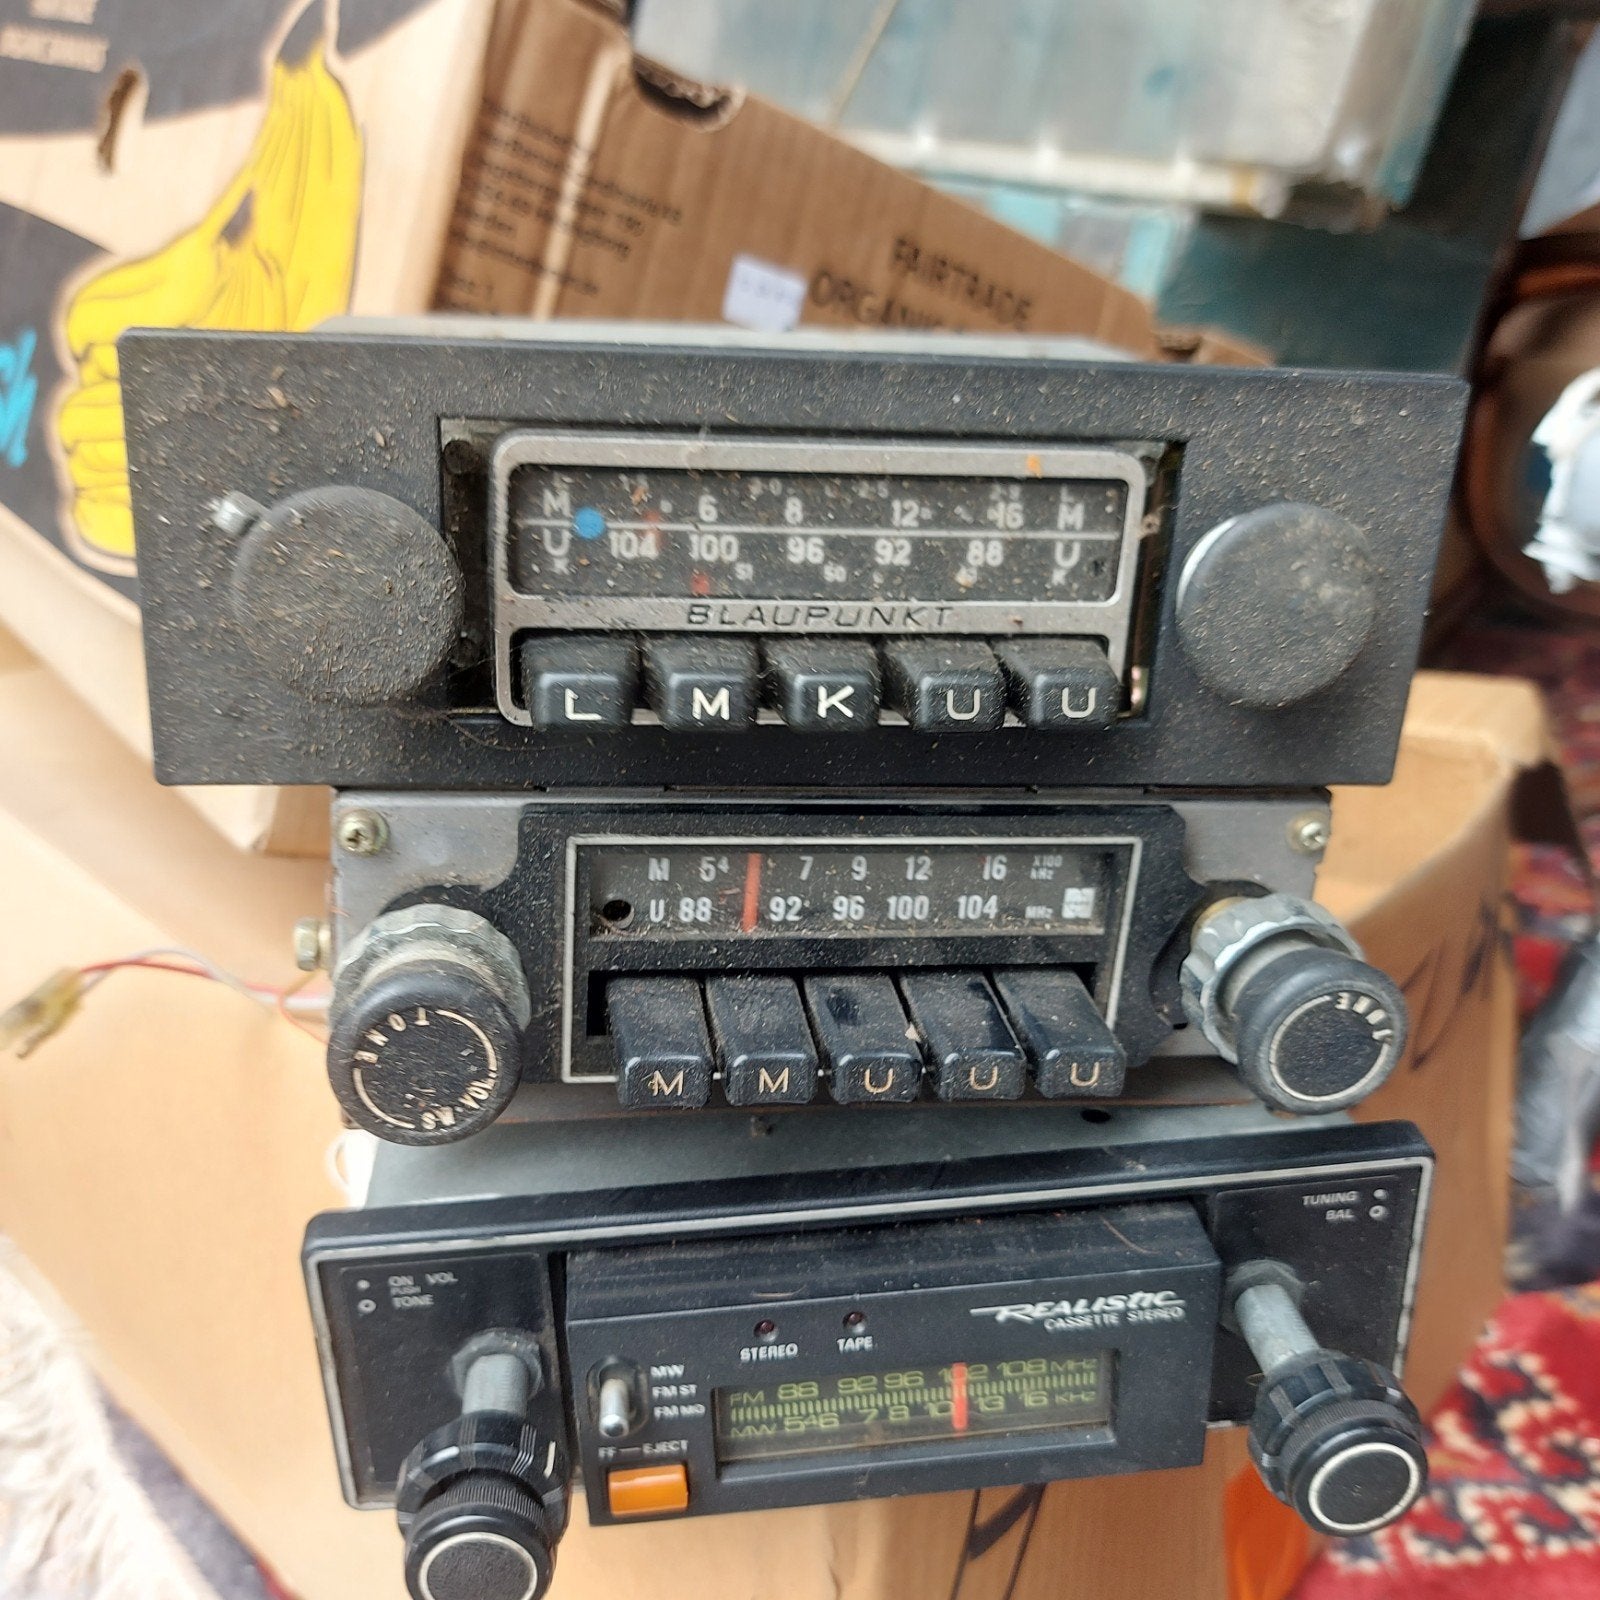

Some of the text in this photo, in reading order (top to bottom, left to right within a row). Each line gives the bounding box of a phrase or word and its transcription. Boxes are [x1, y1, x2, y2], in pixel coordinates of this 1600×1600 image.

[543, 489, 570, 517] M
[699, 495, 717, 522] 6
[785, 496, 803, 524] 8
[892, 500, 919, 527] 12
[1057, 503, 1084, 530] M
[543, 528, 1081, 568] U 104 100 96 92 88 U
[686, 603, 953, 627] BLAUPUNKT
[565, 686, 1096, 721] L M K U U
[648, 857, 670, 881] M
[799, 856, 813, 881] 7
[851, 855, 867, 881] 9
[905, 855, 932, 880] 12
[983, 854, 1007, 880] 16
[650, 898, 664, 922] U
[678, 897, 712, 922] 88
[769, 896, 802, 922] 92
[832, 895, 865, 921] 96
[887, 895, 929, 920] 100
[958, 895, 998, 920] 104
[653, 1062, 1099, 1096] M M U U U
[1302, 1190, 1359, 1206] TUNING
[1325, 1208, 1355, 1221] BAL
[425, 1272, 459, 1285] VOL
[392, 1294, 434, 1309] TONE
[1044, 1306, 1186, 1333] CASSETTE STEREO
[739, 1343, 798, 1361] STEREO
[836, 1335, 873, 1353] TAPE
[650, 1364, 685, 1379] MW
[730, 1390, 764, 1406] FM
[778, 1381, 818, 1400] 88
[837, 1375, 877, 1394] 92
[884, 1370, 924, 1389] 96
[997, 1358, 1046, 1377] 108
[652, 1384, 697, 1400] FM ST
[654, 1405, 679, 1420] FM
[731, 1423, 777, 1438] MW
[858, 1408, 879, 1424] 7
[889, 1405, 909, 1422] 8
[1020, 1391, 1048, 1407] 16
